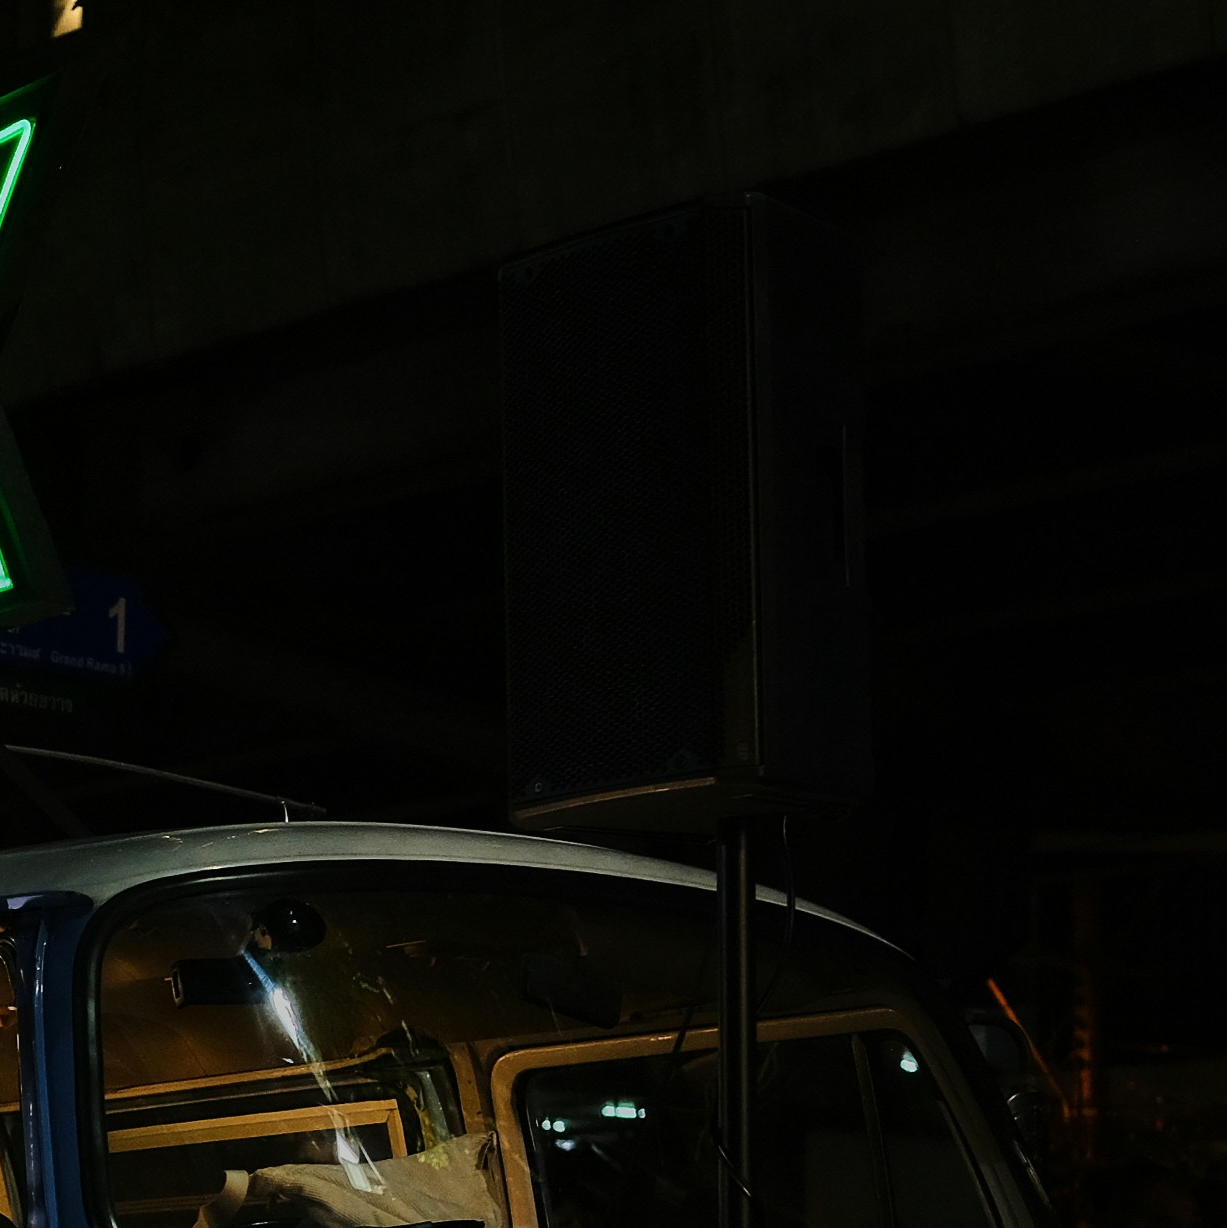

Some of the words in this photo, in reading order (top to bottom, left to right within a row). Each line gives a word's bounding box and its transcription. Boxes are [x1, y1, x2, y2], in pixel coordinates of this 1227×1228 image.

[108, 596, 127, 654] 1
[51, 650, 85, 668] Grand
[86, 657, 117, 675] Rama
